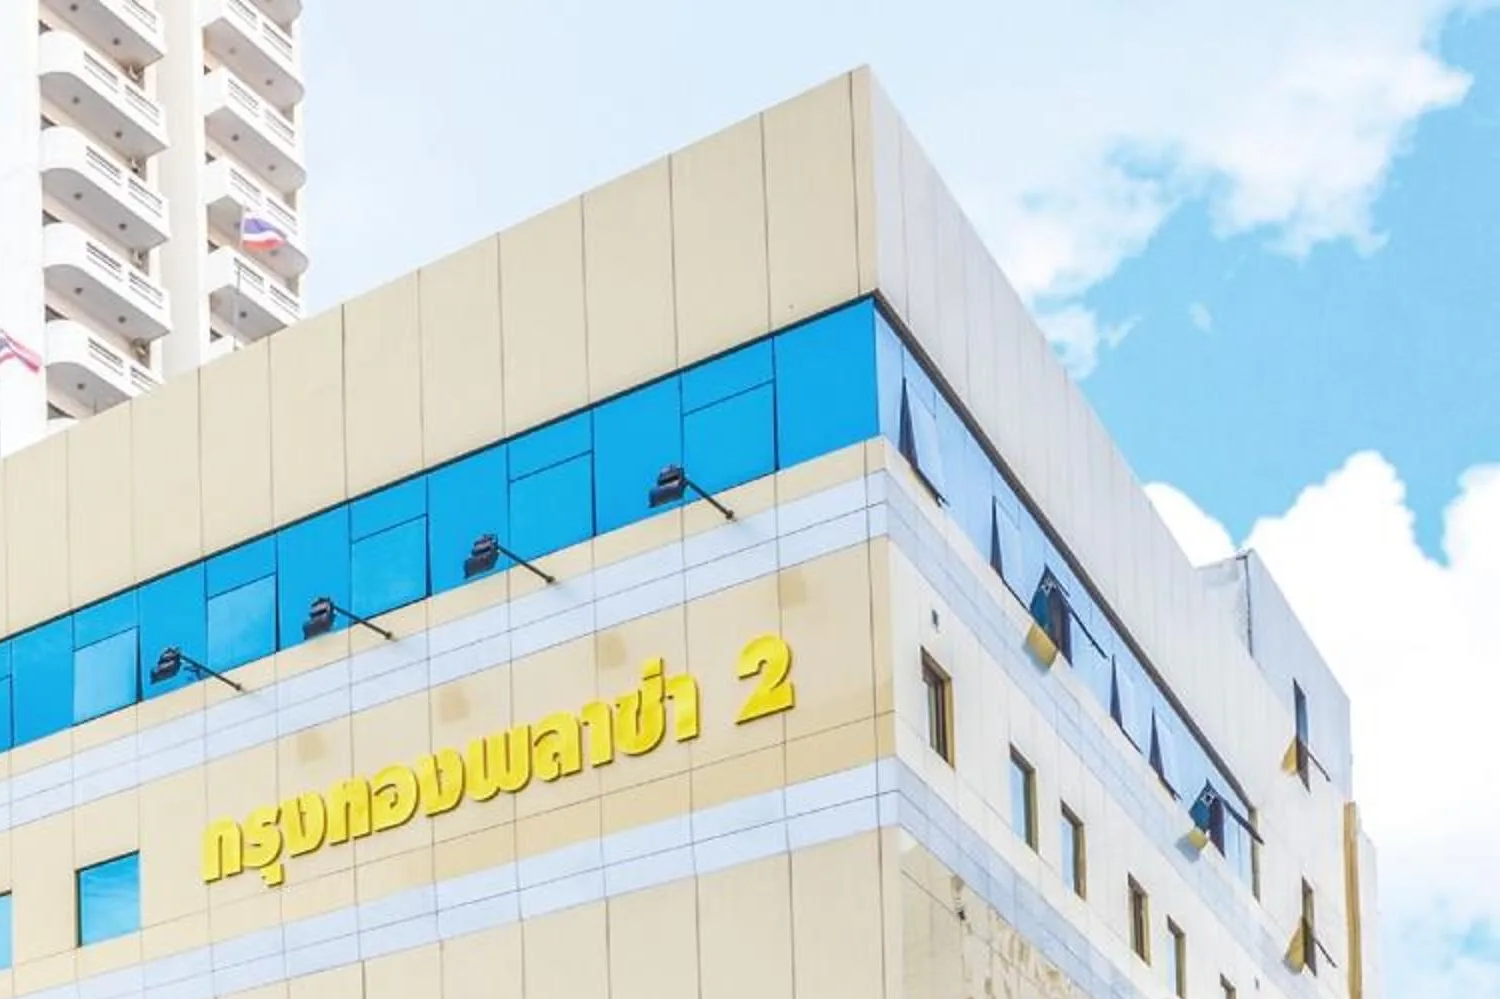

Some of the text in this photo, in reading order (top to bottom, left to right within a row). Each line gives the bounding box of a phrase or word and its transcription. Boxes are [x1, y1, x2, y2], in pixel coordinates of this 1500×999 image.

[203, 634, 796, 886] กรุงทองพลาซ่า 2
